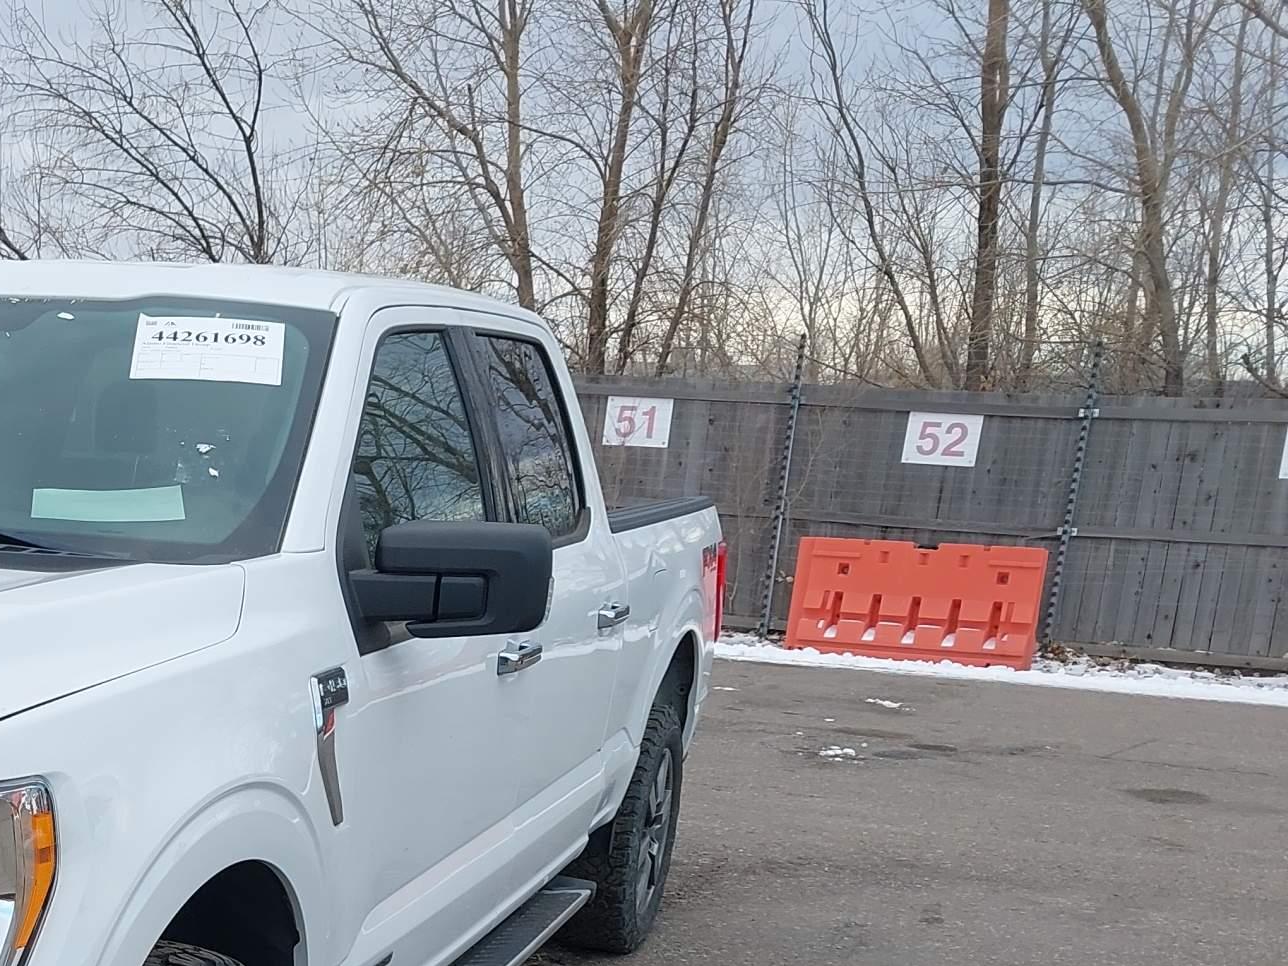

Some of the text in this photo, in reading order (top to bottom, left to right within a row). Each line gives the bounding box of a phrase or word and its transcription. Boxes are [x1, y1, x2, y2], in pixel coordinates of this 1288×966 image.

[151, 330, 266, 347] 44261698
[614, 405, 657, 440] 51
[915, 420, 969, 457] 52
